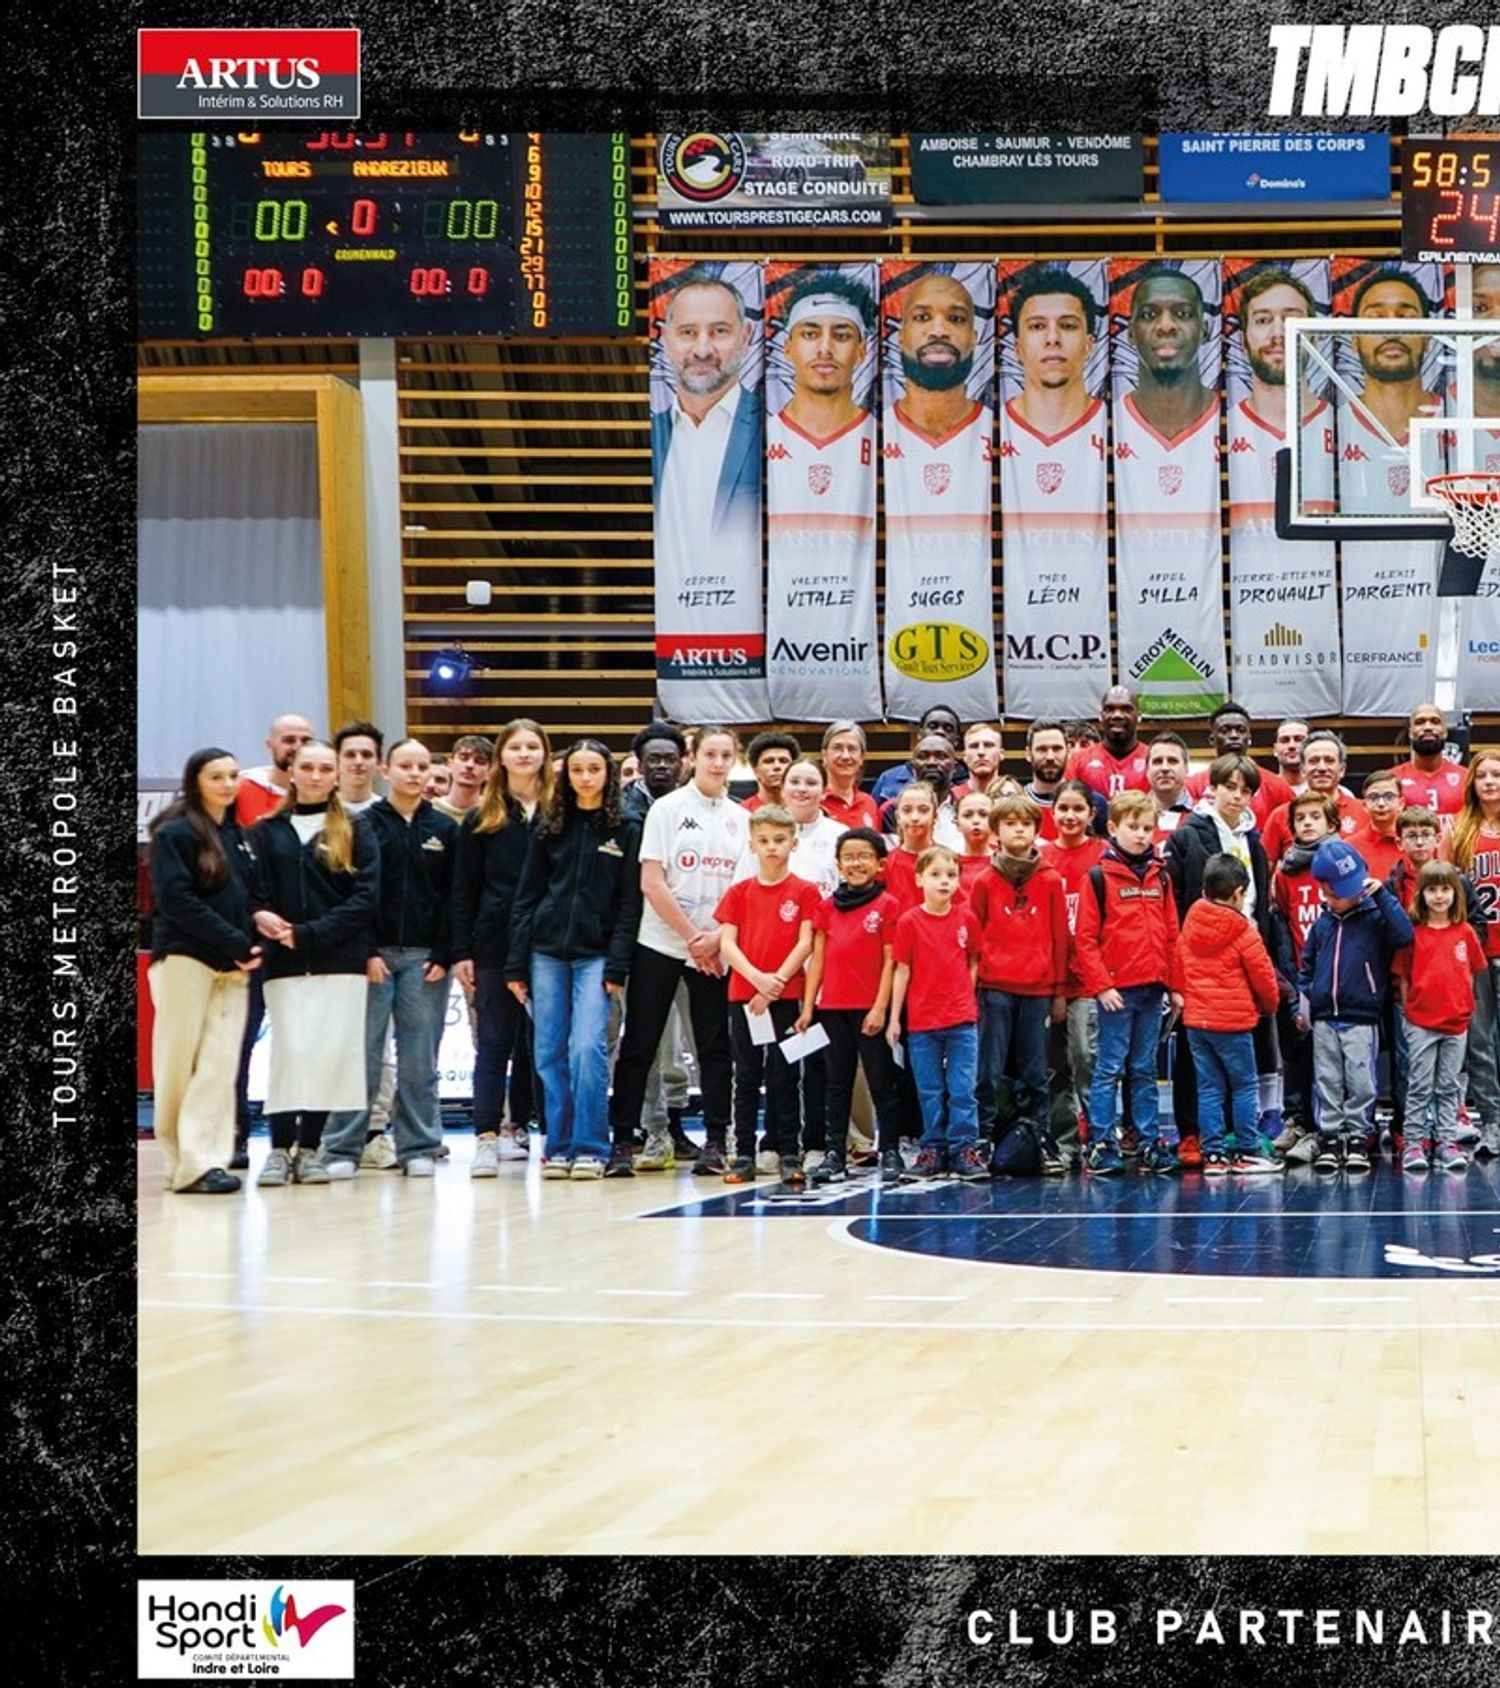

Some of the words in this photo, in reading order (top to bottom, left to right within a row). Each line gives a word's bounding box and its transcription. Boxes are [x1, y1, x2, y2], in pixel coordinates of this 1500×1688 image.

[920, 138, 978, 151] AMBOISE
[995, 137, 1051, 150] SAUMUR
[1068, 134, 1131, 149] VENDÔME
[1182, 140, 1225, 153] SAINT
[1229, 139, 1280, 152] PIERRE
[1285, 139, 1312, 151] DES
[1317, 138, 1365, 151] CORPS
[262, 160, 312, 178] TOURS
[772, 154, 860, 168] ROAD-TRIP
[953, 154, 1024, 168] CHAMBRAY
[1027, 152, 1051, 167] LÈS
[1055, 153, 1099, 166] TOURS
[745, 182, 798, 196] STAGE
[803, 181, 889, 196] CONDUITE
[255, 200, 308, 241] 00
[352, 199, 377, 236] 0
[446, 200, 499, 239] 00
[669, 210, 882, 224] WWW.TOURSPRESTIGECARS.COM
[1430, 190, 1500, 245] 24
[302, 267, 324, 297] 0
[468, 267, 490, 295] 0
[1091, 434, 1104, 462] 4
[677, 589, 737, 608] HEITZ
[786, 589, 856, 608] VITALE
[908, 589, 965, 608] SUGGS
[1027, 585, 1080, 606] LÉON
[1138, 586, 1199, 605] SYLLA
[1238, 583, 1332, 605] DROUAULT
[772, 636, 868, 662] Avenir
[1007, 633, 1107, 661] M.C.P.
[1128, 636, 1168, 680] LEROY
[1163, 626, 1215, 680] MERLIN
[670, 648, 748, 667] ARTUS
[1346, 651, 1424, 663] CERFRANCE
